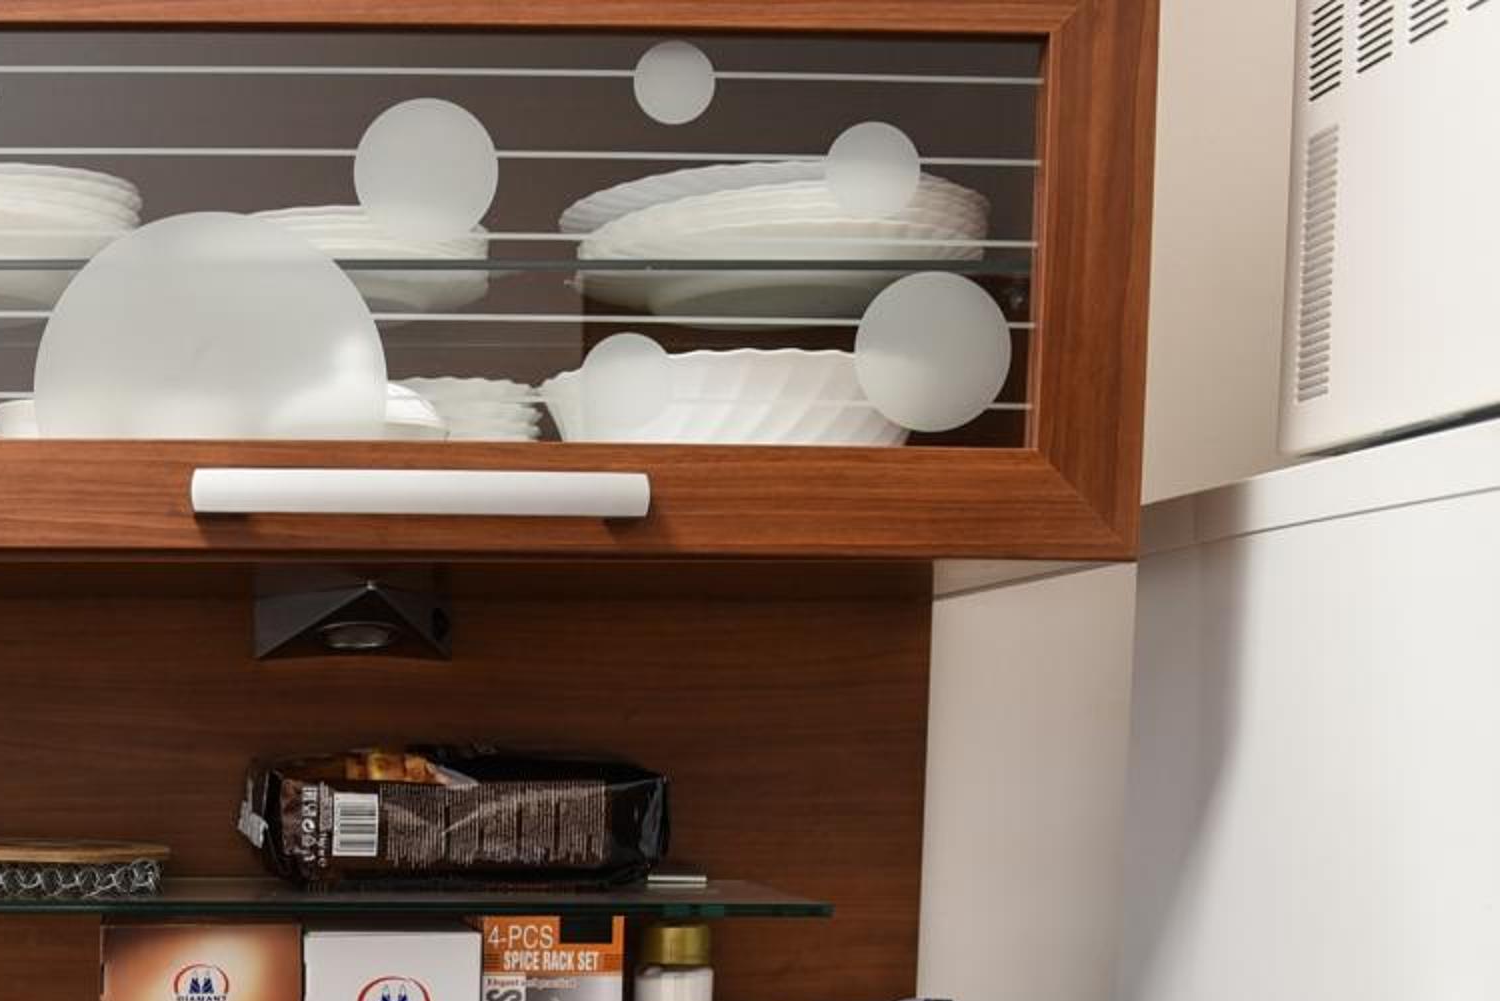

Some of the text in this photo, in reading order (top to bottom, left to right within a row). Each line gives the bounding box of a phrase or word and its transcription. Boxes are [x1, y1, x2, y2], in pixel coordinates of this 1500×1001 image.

[486, 925, 553, 949] 4-PCS
[503, 950, 600, 971] SPICE RACK SET
